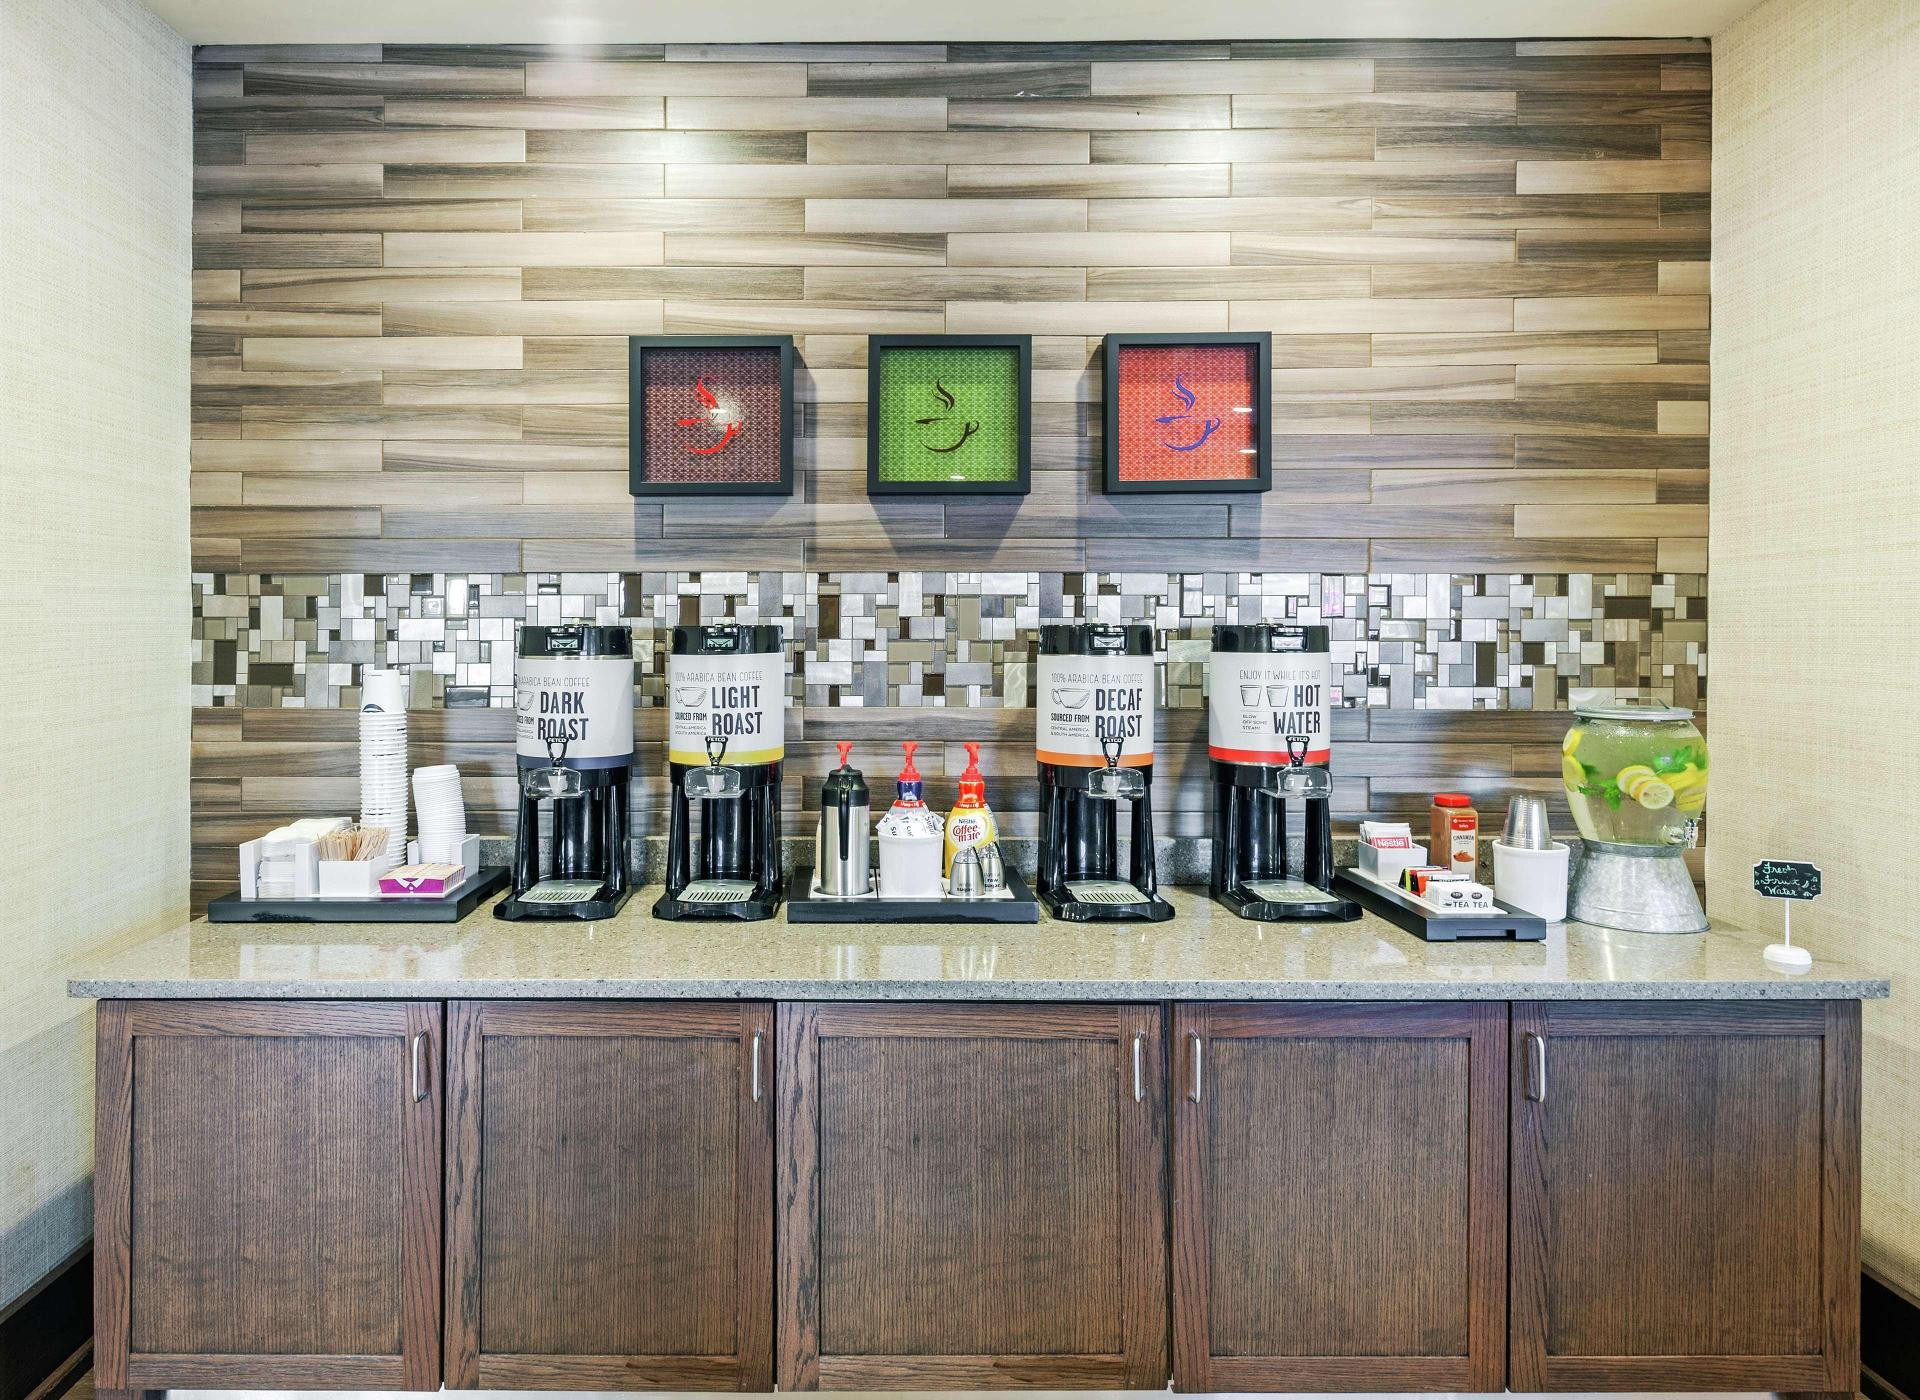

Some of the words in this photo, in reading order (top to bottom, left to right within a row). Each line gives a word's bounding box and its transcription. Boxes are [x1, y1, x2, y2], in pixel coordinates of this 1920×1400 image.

[687, 672, 715, 682] ARABICA
[717, 672, 737, 682] BEAN
[739, 671, 763, 681] COFFEE
[1051, 673, 1066, 683] 100%
[1068, 673, 1099, 684] ARABICA
[1101, 674, 1121, 684] BEAN
[1123, 673, 1143, 683] COFFEE
[1240, 670, 1261, 680] ENJOY
[1264, 670, 1271, 680] IT
[1273, 670, 1297, 680] WHILE
[1311, 670, 1321, 680] HOT
[543, 676, 562, 687] BEAN
[564, 677, 590, 687] COFFEE
[711, 685, 760, 709] LIGHT
[1095, 688, 1143, 711] DECAF
[1294, 684, 1321, 707] HOT
[540, 691, 585, 714] DARK
[524, 716, 535, 725] FROM
[693, 712, 708, 721] FROM
[1050, 712, 1073, 723] SOURCED
[1074, 714, 1090, 723] FROM
[711, 711, 763, 736] ROAST
[1094, 714, 1143, 738] ROAST
[1273, 711, 1321, 735] WATER
[537, 717, 589, 741] ROAST
[958, 832, 981, 842] mate
[1763, 862, 1797, 874] Fresh
[1760, 874, 1801, 886] Fruit
[1765, 885, 1797, 896] Water
[1473, 901, 1489, 909] TEA
